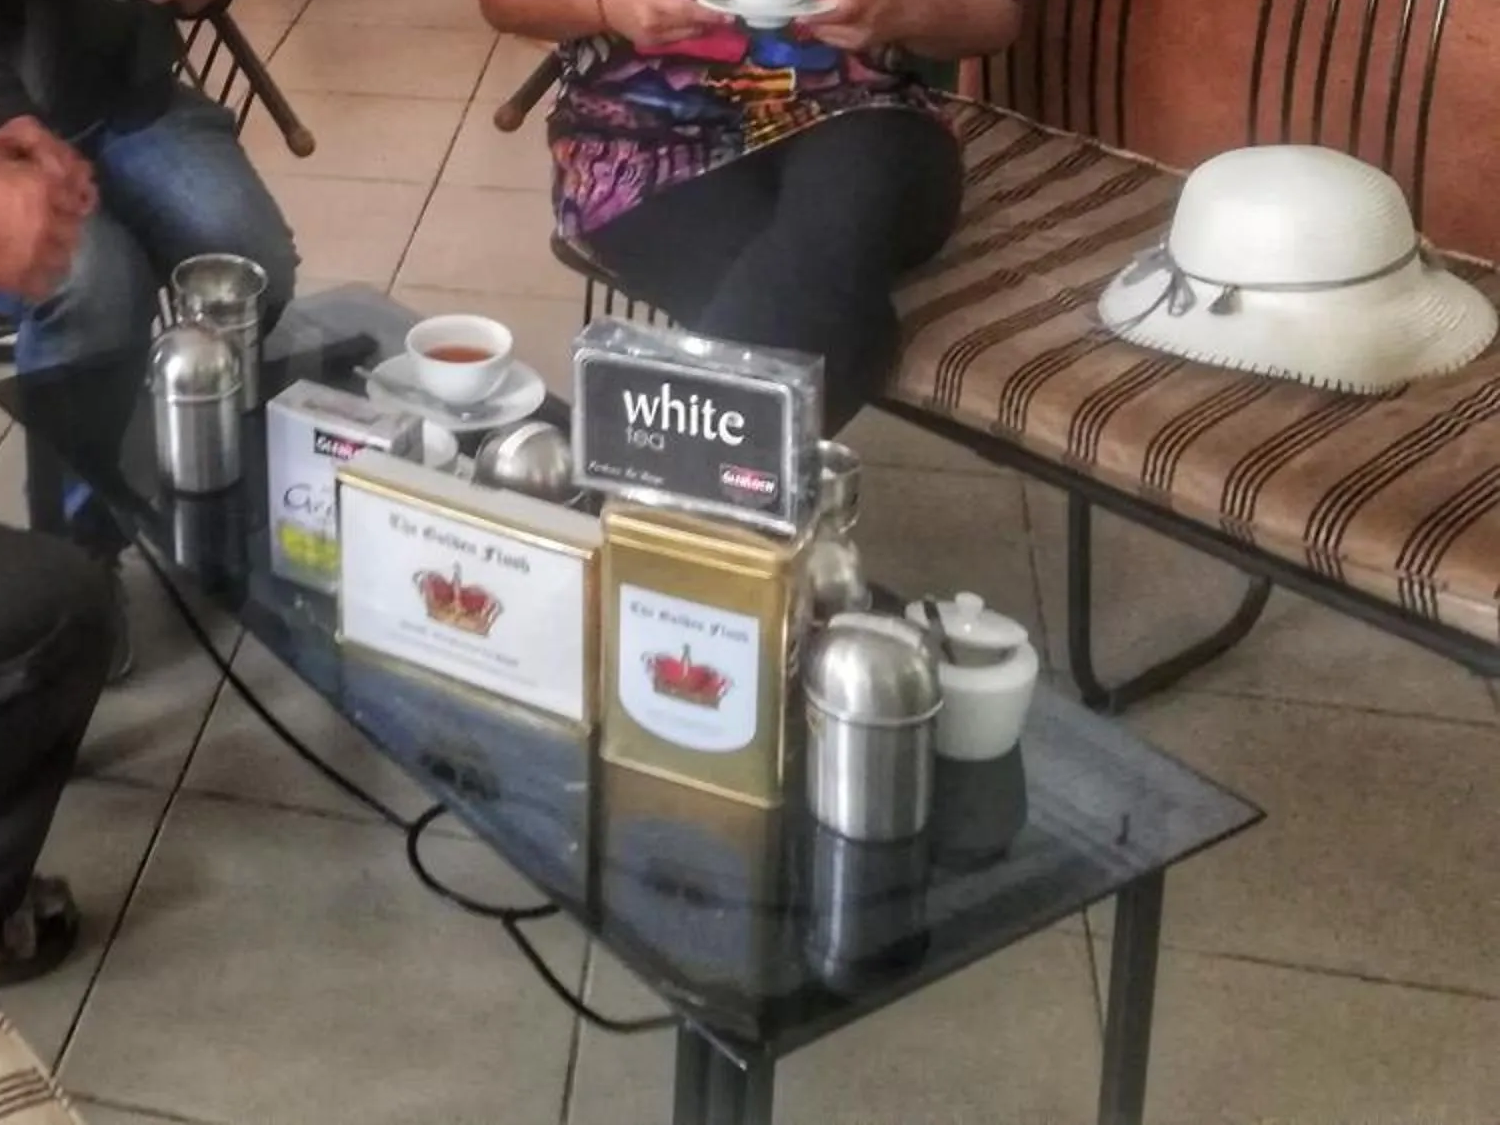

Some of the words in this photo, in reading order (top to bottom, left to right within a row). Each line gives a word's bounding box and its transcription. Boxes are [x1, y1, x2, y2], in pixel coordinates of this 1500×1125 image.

[623, 383, 745, 446] white
[626, 427, 665, 450] tea
[389, 512, 418, 536] The
[422, 526, 477, 555] Golden
[483, 546, 531, 574] Flush
[629, 600, 654, 618] The
[659, 610, 704, 632] Golden
[710, 622, 750, 644] Flush
